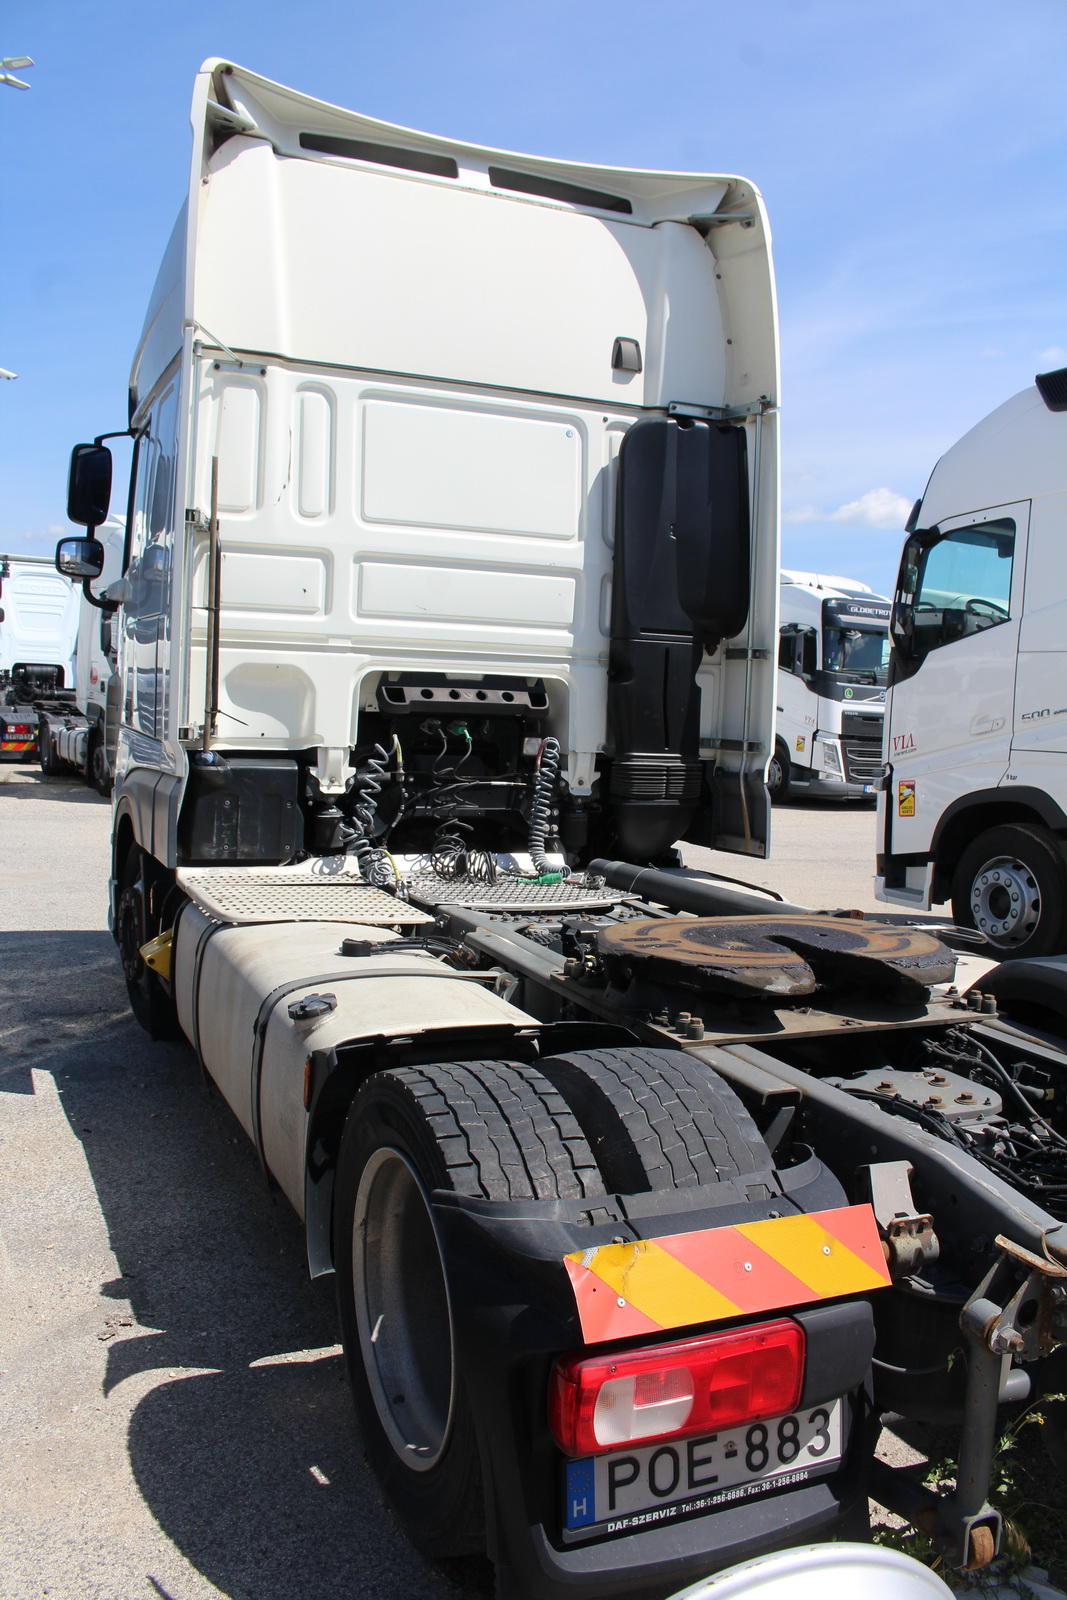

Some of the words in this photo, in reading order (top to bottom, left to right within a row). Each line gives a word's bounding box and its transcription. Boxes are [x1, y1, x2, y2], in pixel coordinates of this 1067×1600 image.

[1021, 708, 1050, 723] 500
[892, 733, 916, 751] VIA
[608, 1408, 831, 1511] POE-883
[572, 1497, 587, 1518] H
[607, 1506, 677, 1533] DAF-SZERVIZ
[747, 1486, 761, 1495] Fax:
